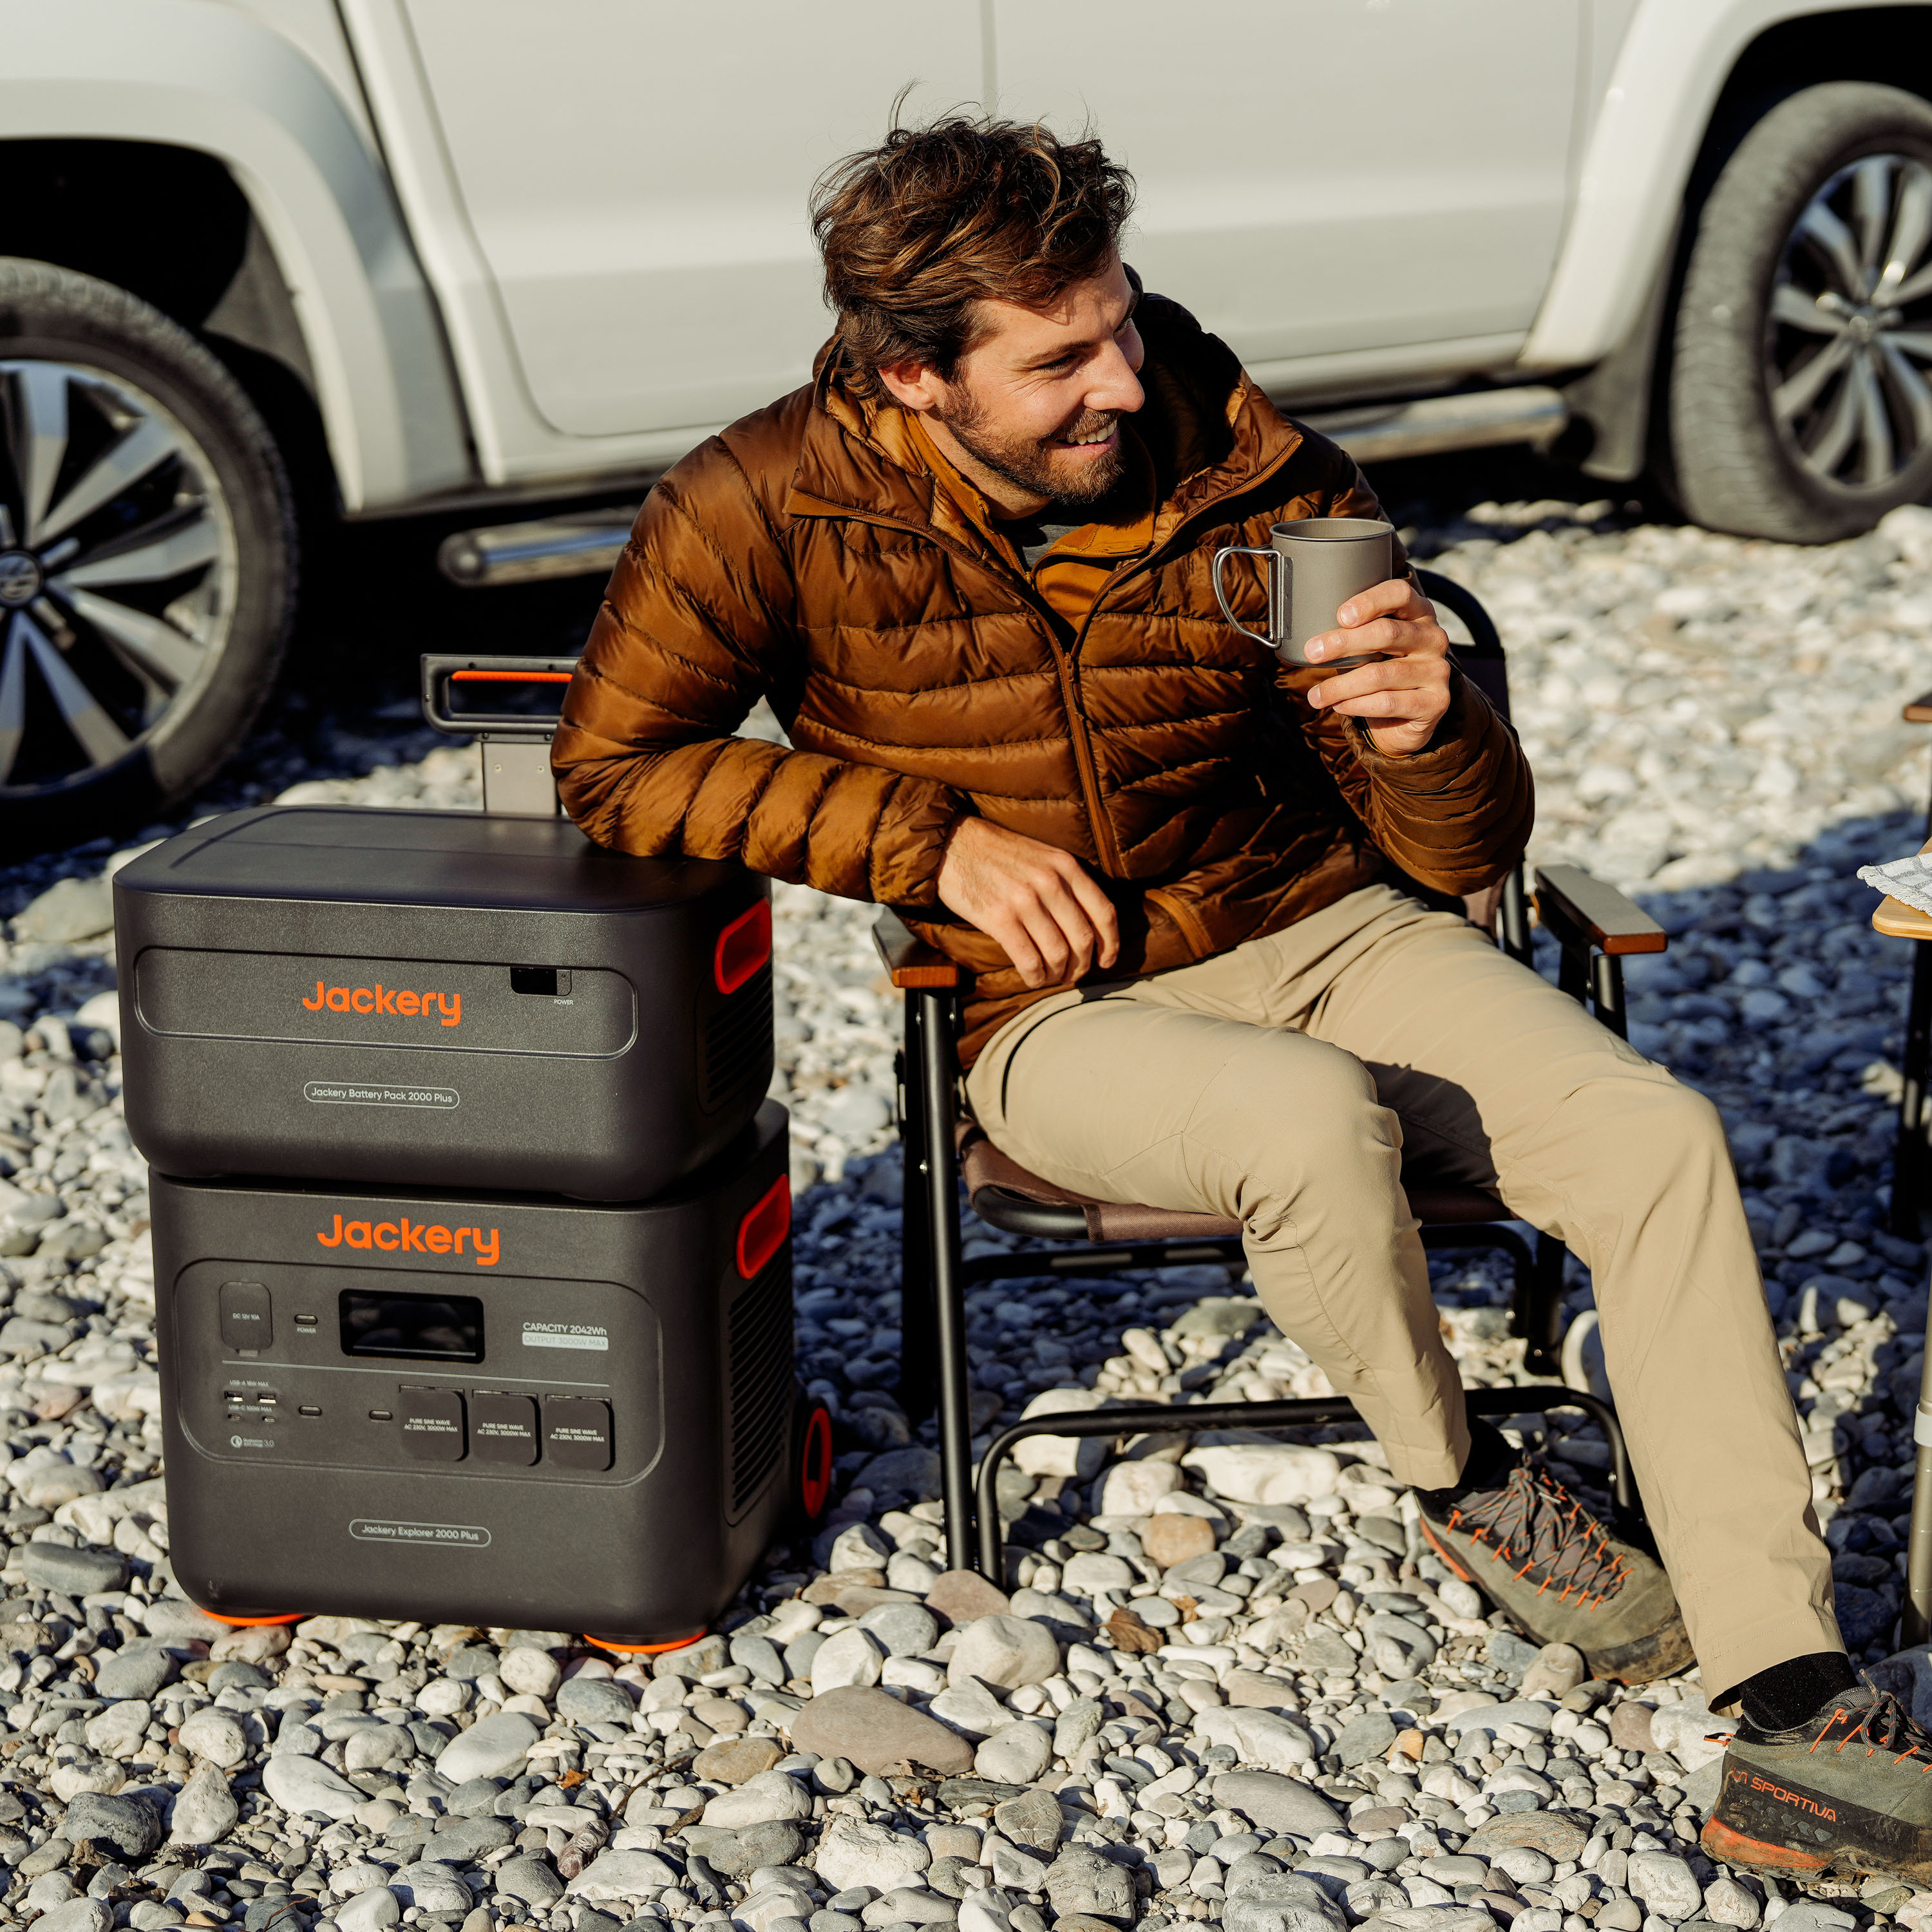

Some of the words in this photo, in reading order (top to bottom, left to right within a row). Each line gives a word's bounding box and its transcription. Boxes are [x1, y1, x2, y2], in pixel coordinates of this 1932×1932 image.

[303, 982, 461, 1027] Jackery
[311, 1087, 347, 1099] Jackery
[348, 1088, 383, 1101] Battery
[384, 1090, 406, 1101] Pack
[408, 1092, 432, 1102] 2000
[434, 1093, 453, 1103] Plus
[317, 1215, 500, 1265] Jackery
[523, 1321, 568, 1333] CAPACITY
[569, 1325, 607, 1336] 2042Wh
[524, 1335, 555, 1344] OUTPUT
[558, 1337, 587, 1346] 3000W
[589, 1339, 607, 1347] MAX
[361, 1524, 397, 1537] Jackery
[398, 1526, 434, 1539] Explorer
[435, 1529, 460, 1540] 2000
[460, 1530, 480, 1541] Plus
[1732, 1766, 1748, 1785] LA
[1750, 1777, 1837, 1823] SPORTIVA
